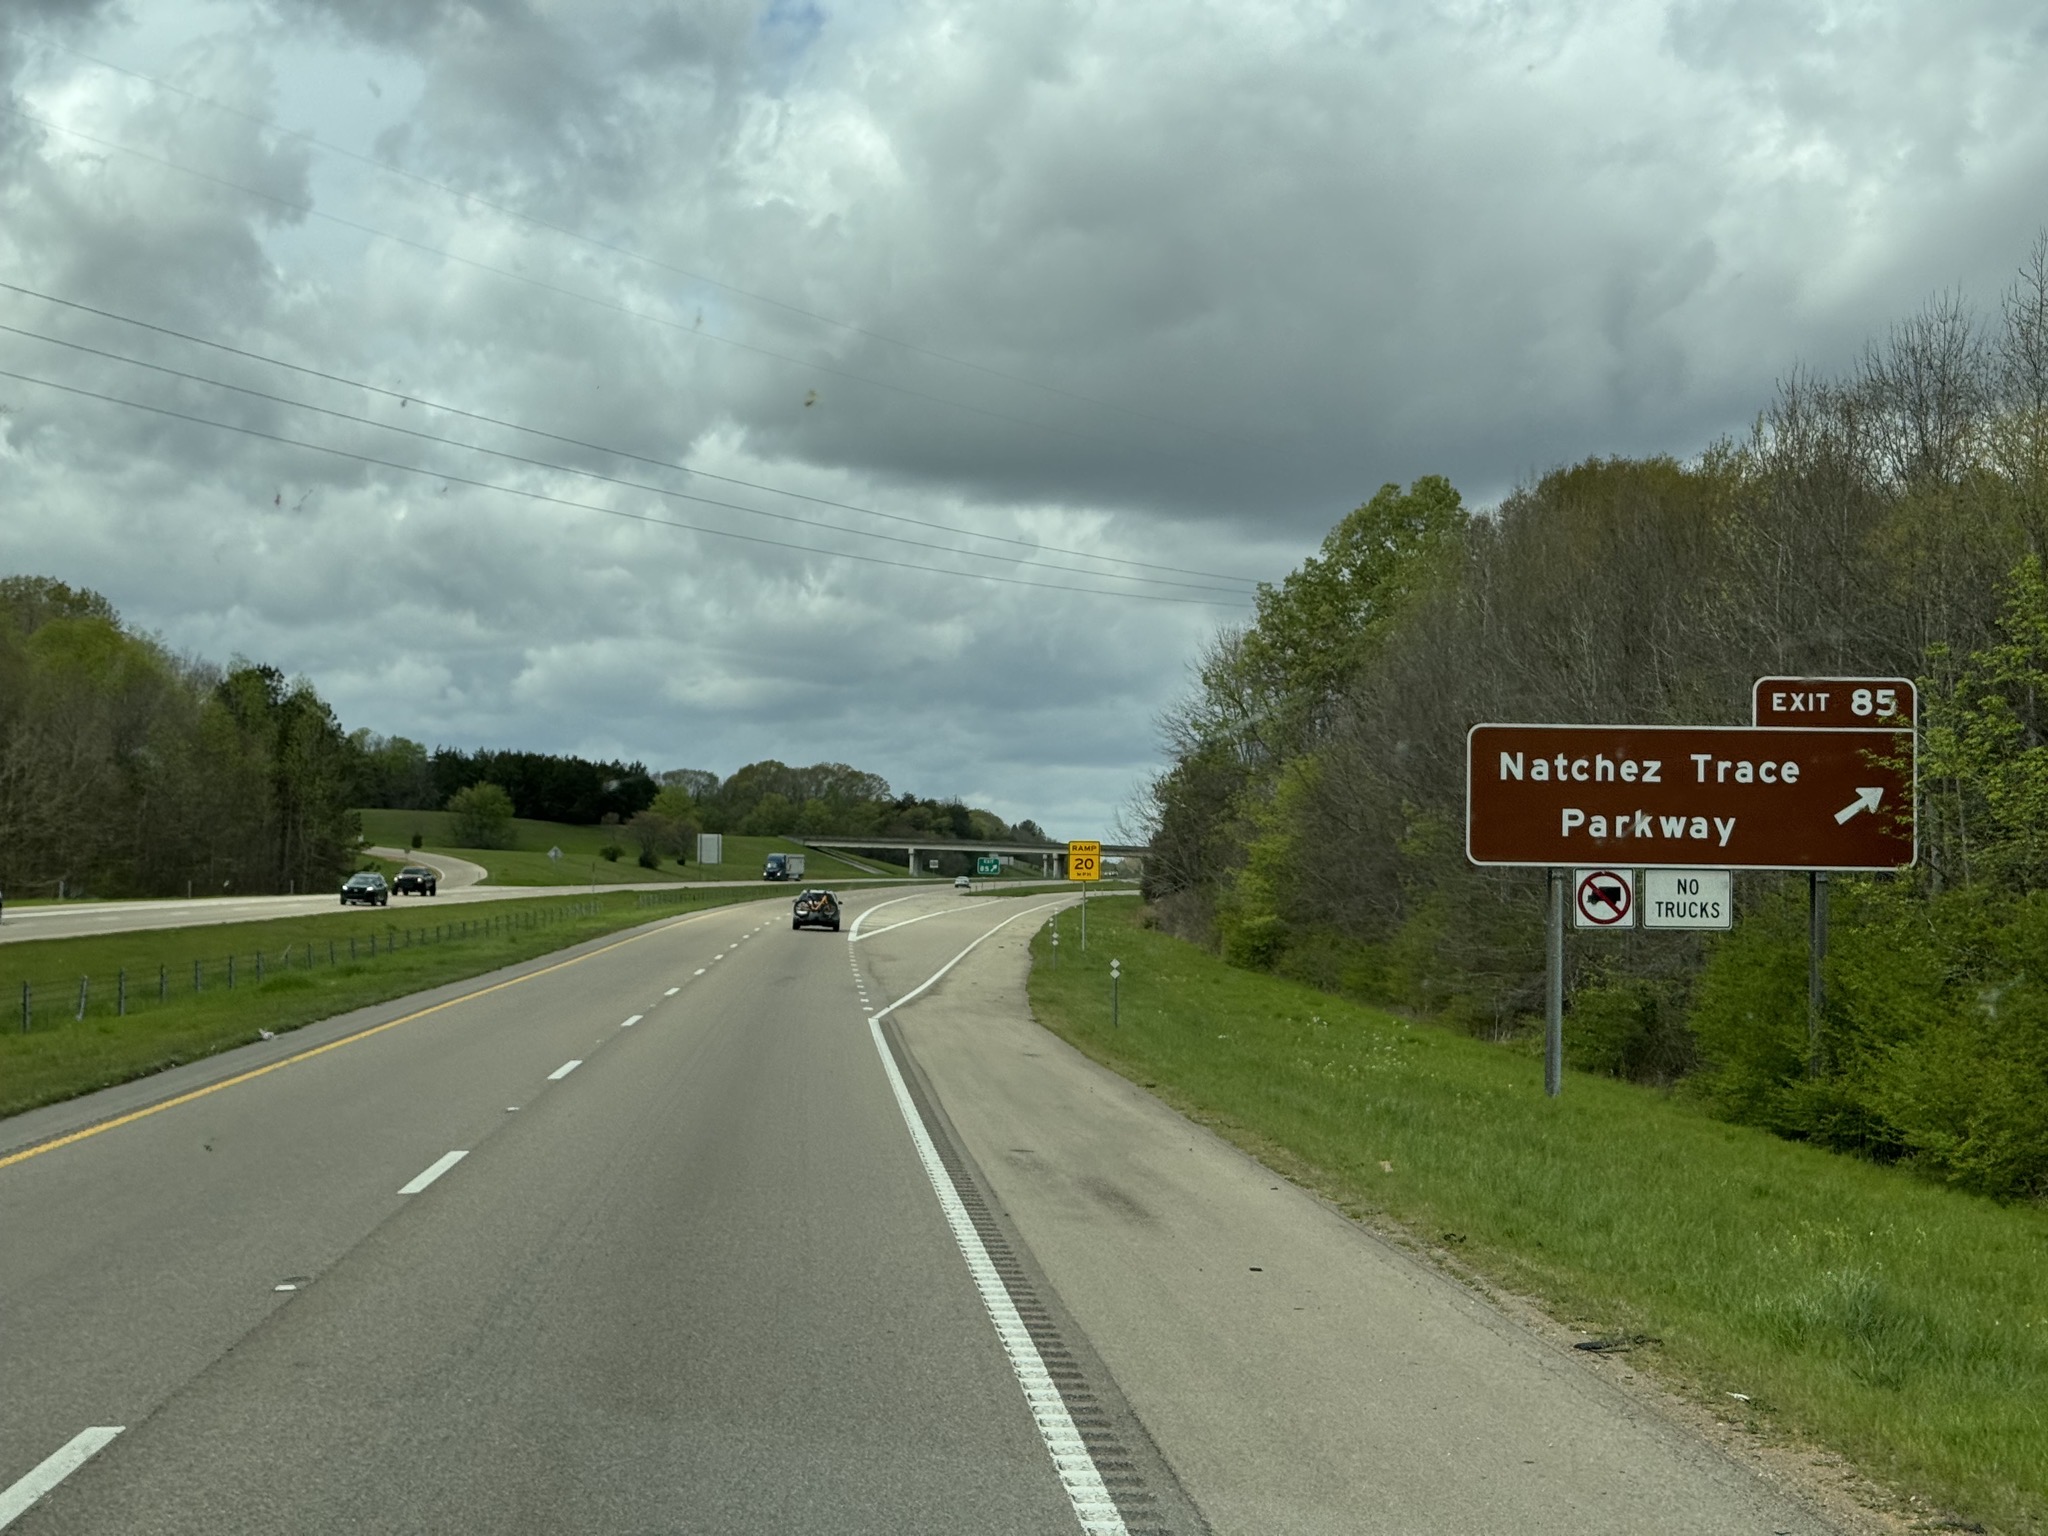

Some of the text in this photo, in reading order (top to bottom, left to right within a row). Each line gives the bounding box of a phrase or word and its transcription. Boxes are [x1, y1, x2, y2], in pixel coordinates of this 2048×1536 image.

[1772, 688, 1897, 717] EXIT 85
[1500, 751, 1800, 784] Natchez Trace
[1561, 808, 1736, 847] Parkway
[1074, 858, 1094, 870] 20
[1677, 878, 1700, 896] NO
[1655, 901, 1720, 919] TRUCKS
